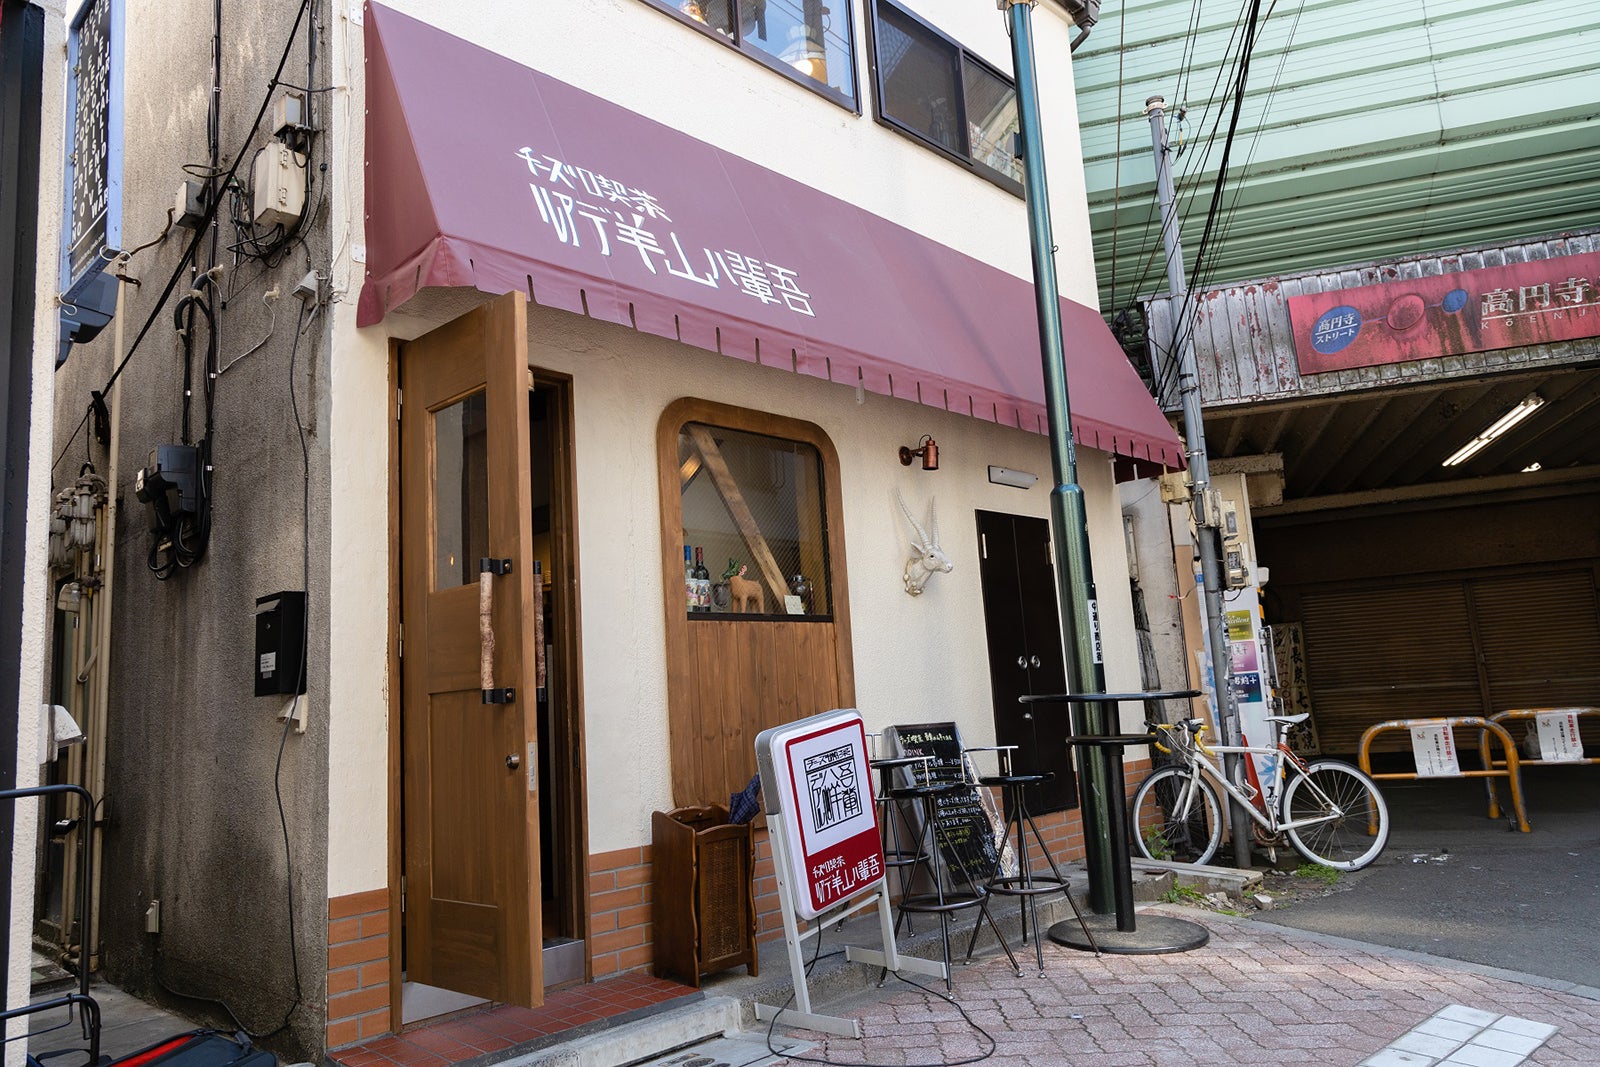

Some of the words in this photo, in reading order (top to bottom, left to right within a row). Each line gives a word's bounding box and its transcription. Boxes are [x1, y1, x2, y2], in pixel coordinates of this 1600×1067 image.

[1481, 277, 1600, 317] 高円寺
[1318, 312, 1356, 332] 高円寺
[1315, 328, 1355, 346] ストリート
